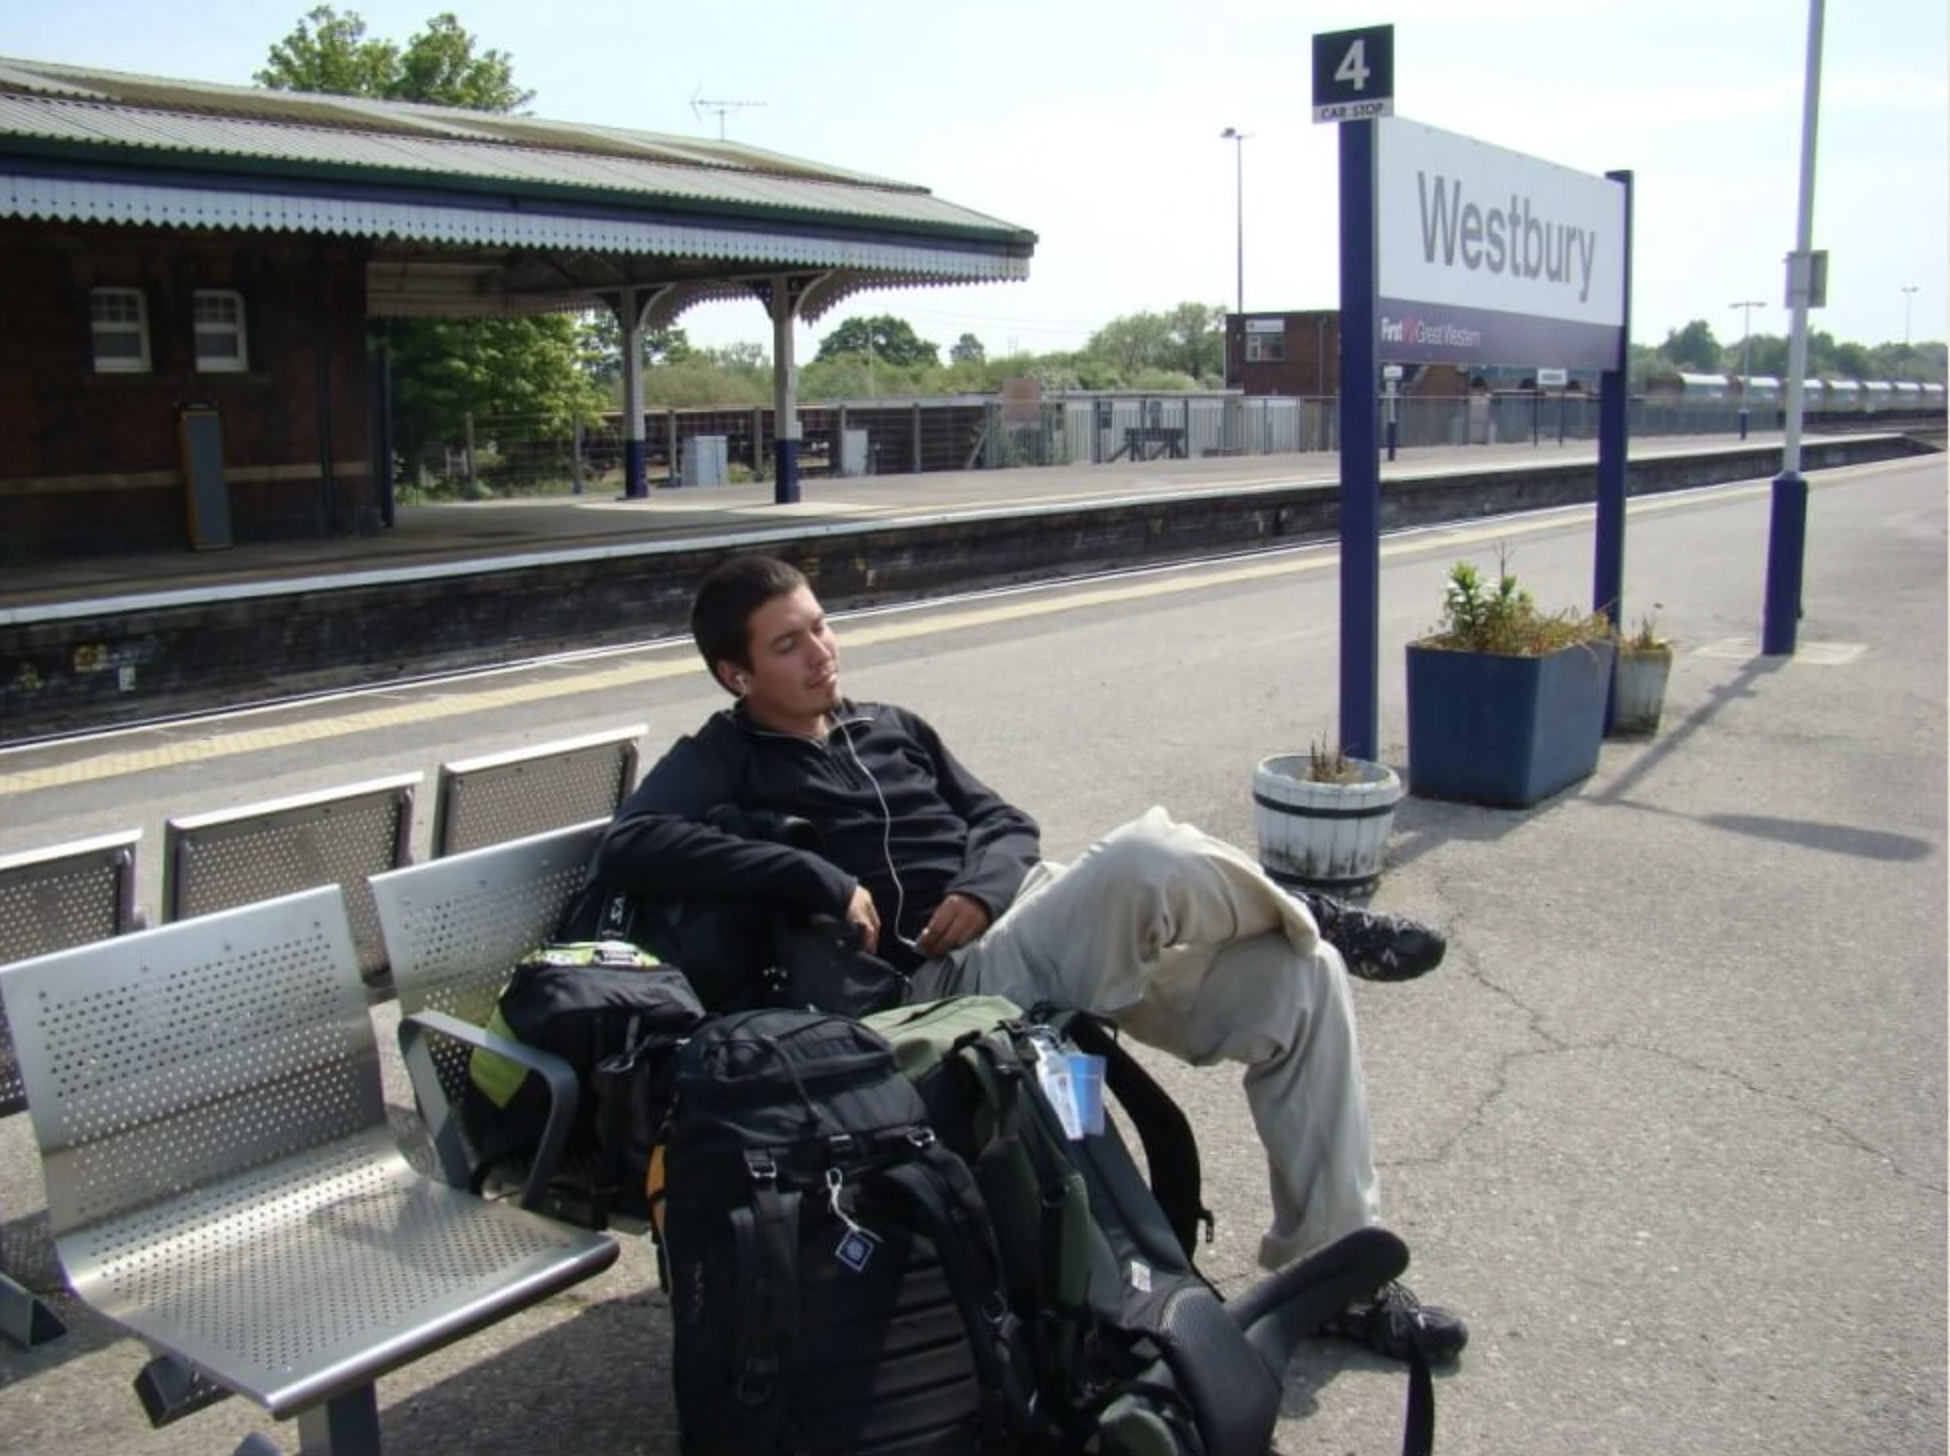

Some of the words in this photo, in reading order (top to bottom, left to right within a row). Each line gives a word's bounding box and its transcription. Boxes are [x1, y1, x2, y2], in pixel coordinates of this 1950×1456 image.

[1334, 39, 1371, 91] 4
[1321, 105, 1347, 120] CAR
[1352, 102, 1385, 118] STOP
[1417, 170, 1597, 304] Westbury
